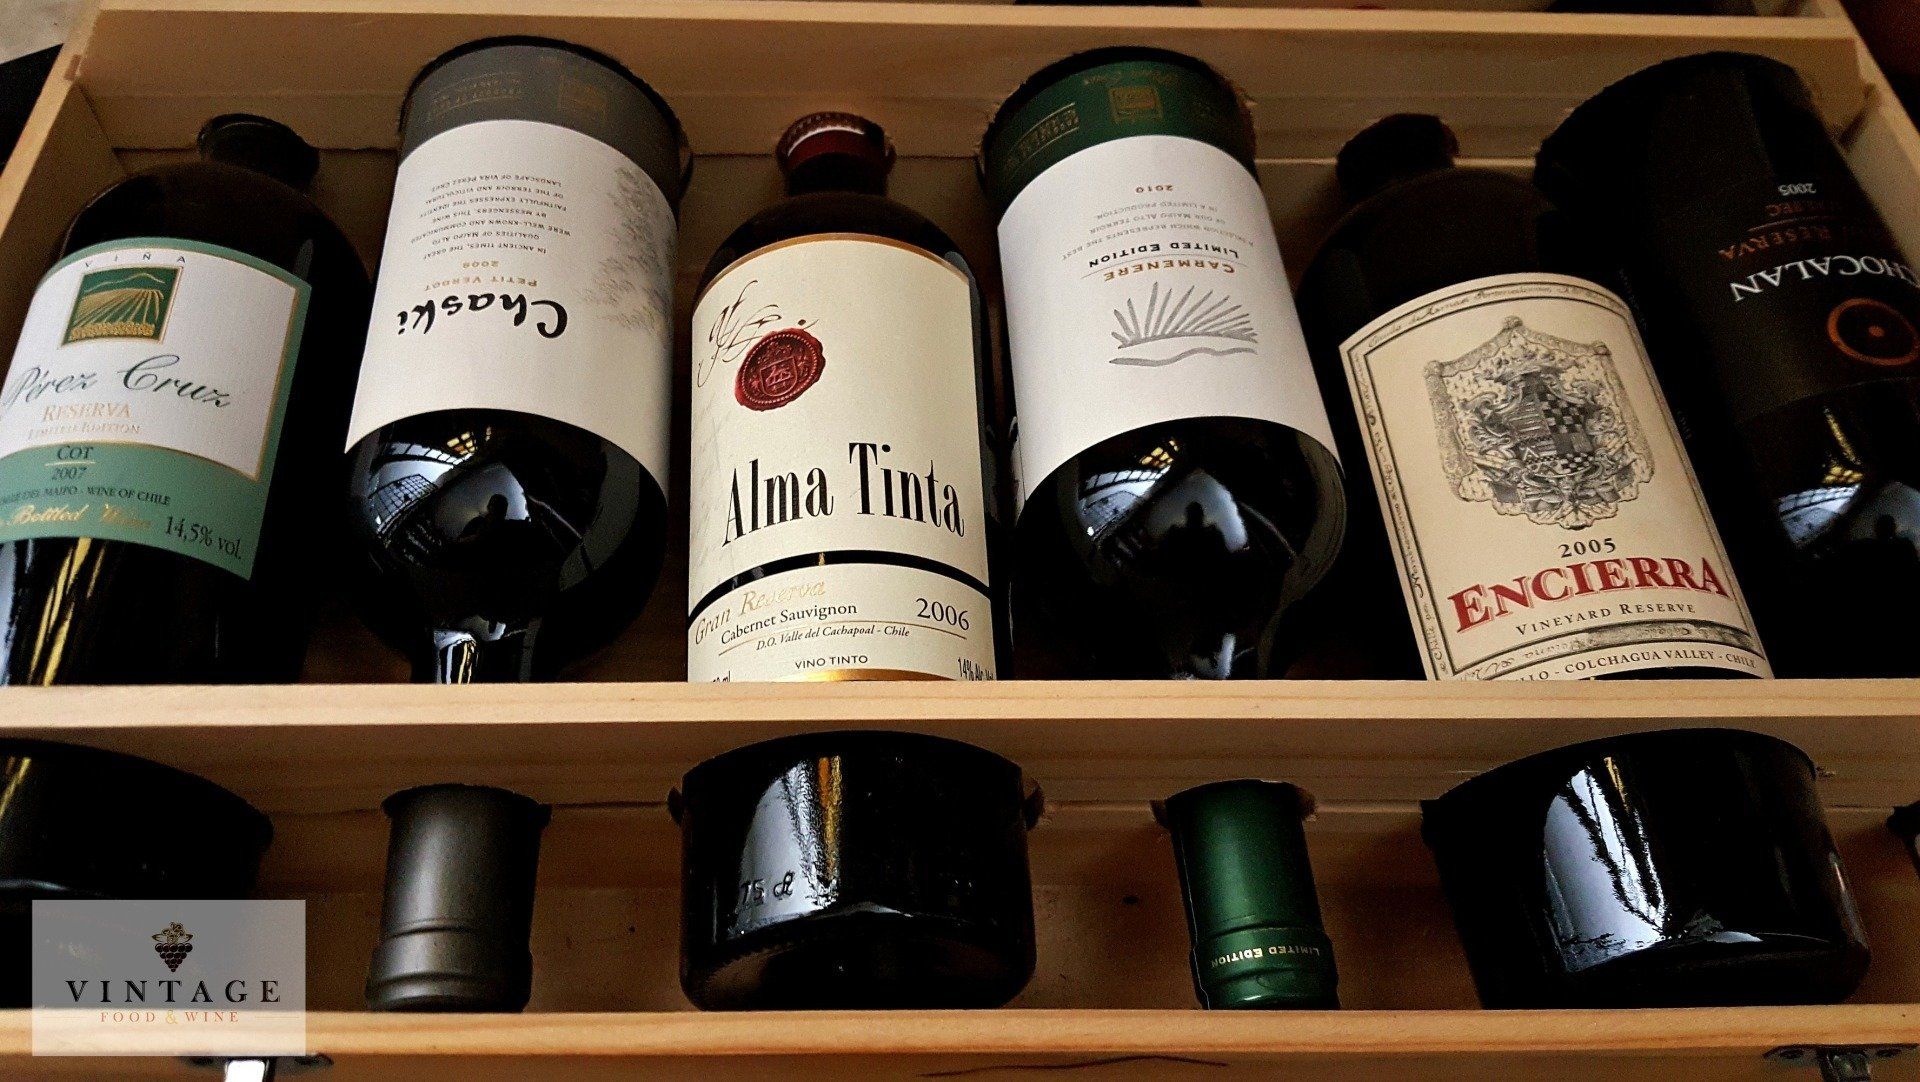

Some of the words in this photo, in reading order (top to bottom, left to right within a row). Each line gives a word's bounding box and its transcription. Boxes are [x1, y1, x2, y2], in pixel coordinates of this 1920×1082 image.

[1135, 184, 1173, 194] 2010
[1088, 243, 1160, 268] EDITION
[1169, 242, 1239, 259] LIMITED
[1103, 259, 1236, 282] CARMENERE
[424, 276, 482, 292] VERDOT
[490, 276, 538, 288] PETIT
[396, 293, 568, 340] Chaski
[117, 354, 231, 409] Cruz
[42, 402, 131, 422] RESERVA
[57, 445, 95, 460] COT
[51, 466, 88, 481] 2007
[137, 491, 171, 506] CHILE
[722, 458, 835, 548] Alma
[848, 442, 965, 538] Tinta
[1559, 537, 1617, 559] 2005
[1447, 556, 1732, 634] ENCIERRA
[694, 607, 731, 645] Gran
[739, 580, 826, 617] Reserva
[915, 597, 970, 631] 2006
[1516, 607, 1611, 637] VINEYARD
[1619, 602, 1697, 615] RESERVE
[721, 615, 776, 645] Cabernet
[780, 603, 858, 623] Sauvignon
[780, 631, 803, 644] Valle
[805, 627, 820, 639] del
[822, 624, 875, 638] Cachapoal
[884, 624, 911, 638] Chile
[795, 657, 826, 670] VINO
[829, 654, 869, 666] TINTO
[1564, 651, 1662, 674] COLCHAGUA
[1662, 649, 1715, 660] VALLEY
[1725, 653, 1757, 669] CHILE
[1210, 947, 1263, 968] EDITION
[1268, 944, 1320, 957] LIMITED
